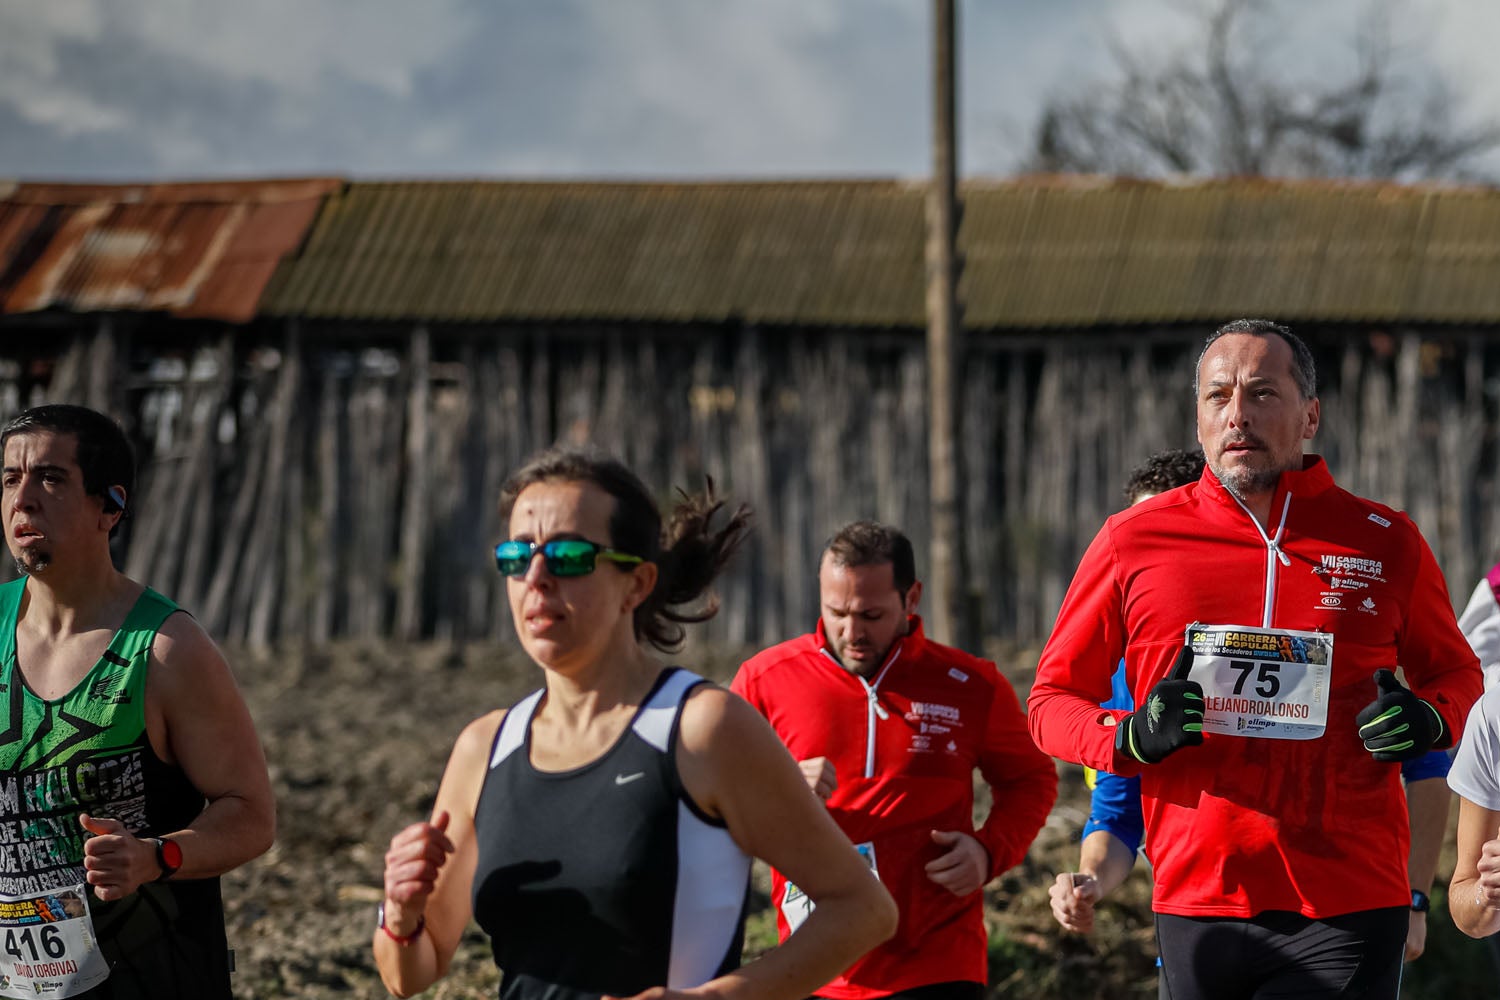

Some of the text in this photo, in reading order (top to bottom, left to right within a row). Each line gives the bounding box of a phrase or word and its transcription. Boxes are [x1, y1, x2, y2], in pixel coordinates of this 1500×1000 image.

[1336, 556, 1383, 568] CARRERA
[1336, 562, 1382, 575] POPULAR
[1342, 579, 1369, 588] olimpo
[1193, 632, 1207, 642] 26
[1225, 632, 1277, 645] CARRERA
[1225, 640, 1277, 651] POPULAR
[1221, 647, 1253, 656] Secaderos
[1230, 660, 1280, 698] 75
[1248, 718, 1276, 727] olimpo
[5, 925, 66, 961] 416
[42, 981, 63, 990] olimpo
